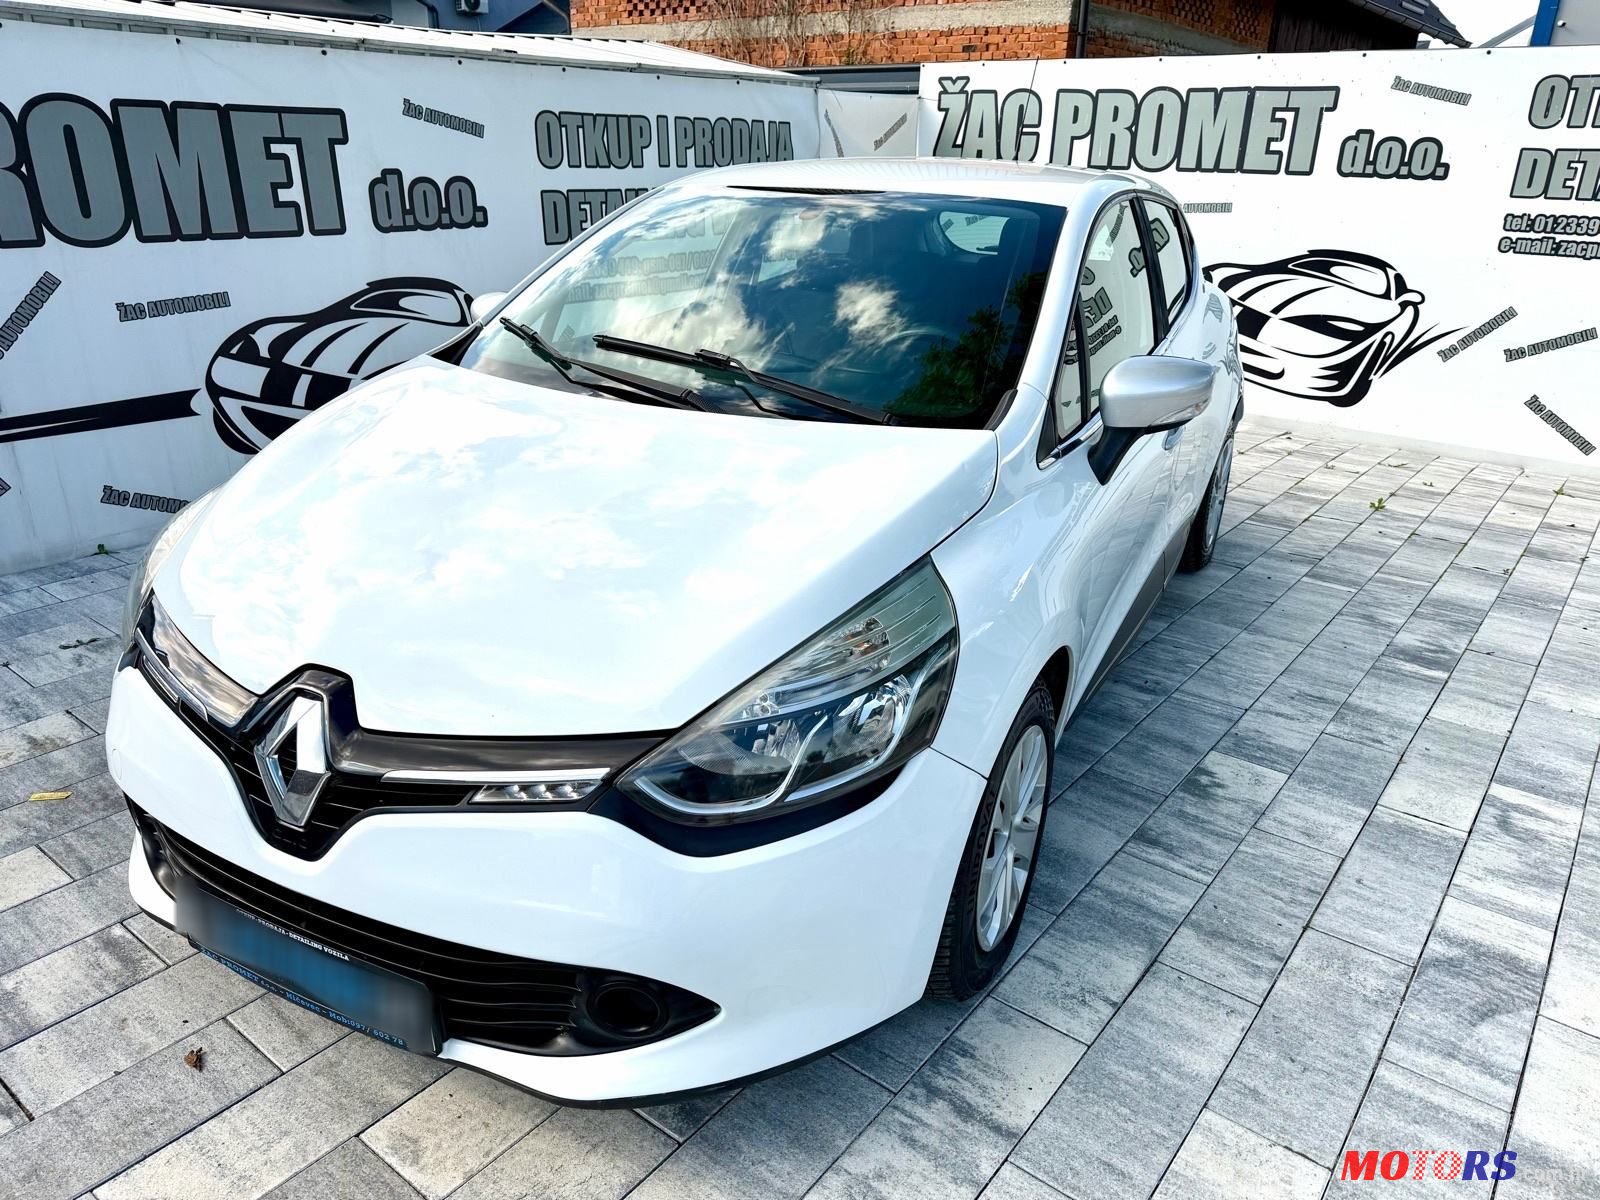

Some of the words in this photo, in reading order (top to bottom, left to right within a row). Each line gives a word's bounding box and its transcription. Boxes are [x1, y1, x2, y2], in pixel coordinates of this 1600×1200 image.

[1390, 75, 1412, 92] ŽAC
[1409, 82, 1472, 106] AUTOMOBILI
[402, 98, 424, 121] ŽAC
[423, 107, 485, 139] AUTOMOBILI
[935, 76, 1042, 161] ŽAC
[1050, 86, 1341, 176] PROMET
[1336, 129, 1450, 181] d.o.o.
[534, 110, 652, 169] OTKUP
[656, 115, 671, 168] I
[675, 116, 795, 169] PRODAJA
[1509, 147, 1600, 201] DET
[368, 168, 488, 234] d.o.o.
[1182, 202, 1233, 214] AUTOMOBILI
[1503, 213, 1532, 232] tel:
[1498, 236, 1556, 257] e-mail:
[0, 271, 62, 352] AUTOMOBILI
[115, 302, 147, 322] ŽAC
[147, 291, 231, 318] AUTOMOBILI
[1437, 344, 1461, 363] ŽAC
[1456, 306, 1518, 352] AUTOMOBILI
[1504, 347, 1527, 362] ŽAC
[1527, 327, 1598, 357] AUTOMOBILI
[1523, 394, 1547, 415] ŽAC
[1539, 409, 1597, 457] AUTOMOBILI
[101, 485, 130, 506] ŽAC
[323, 946, 350, 961] VOZILA
